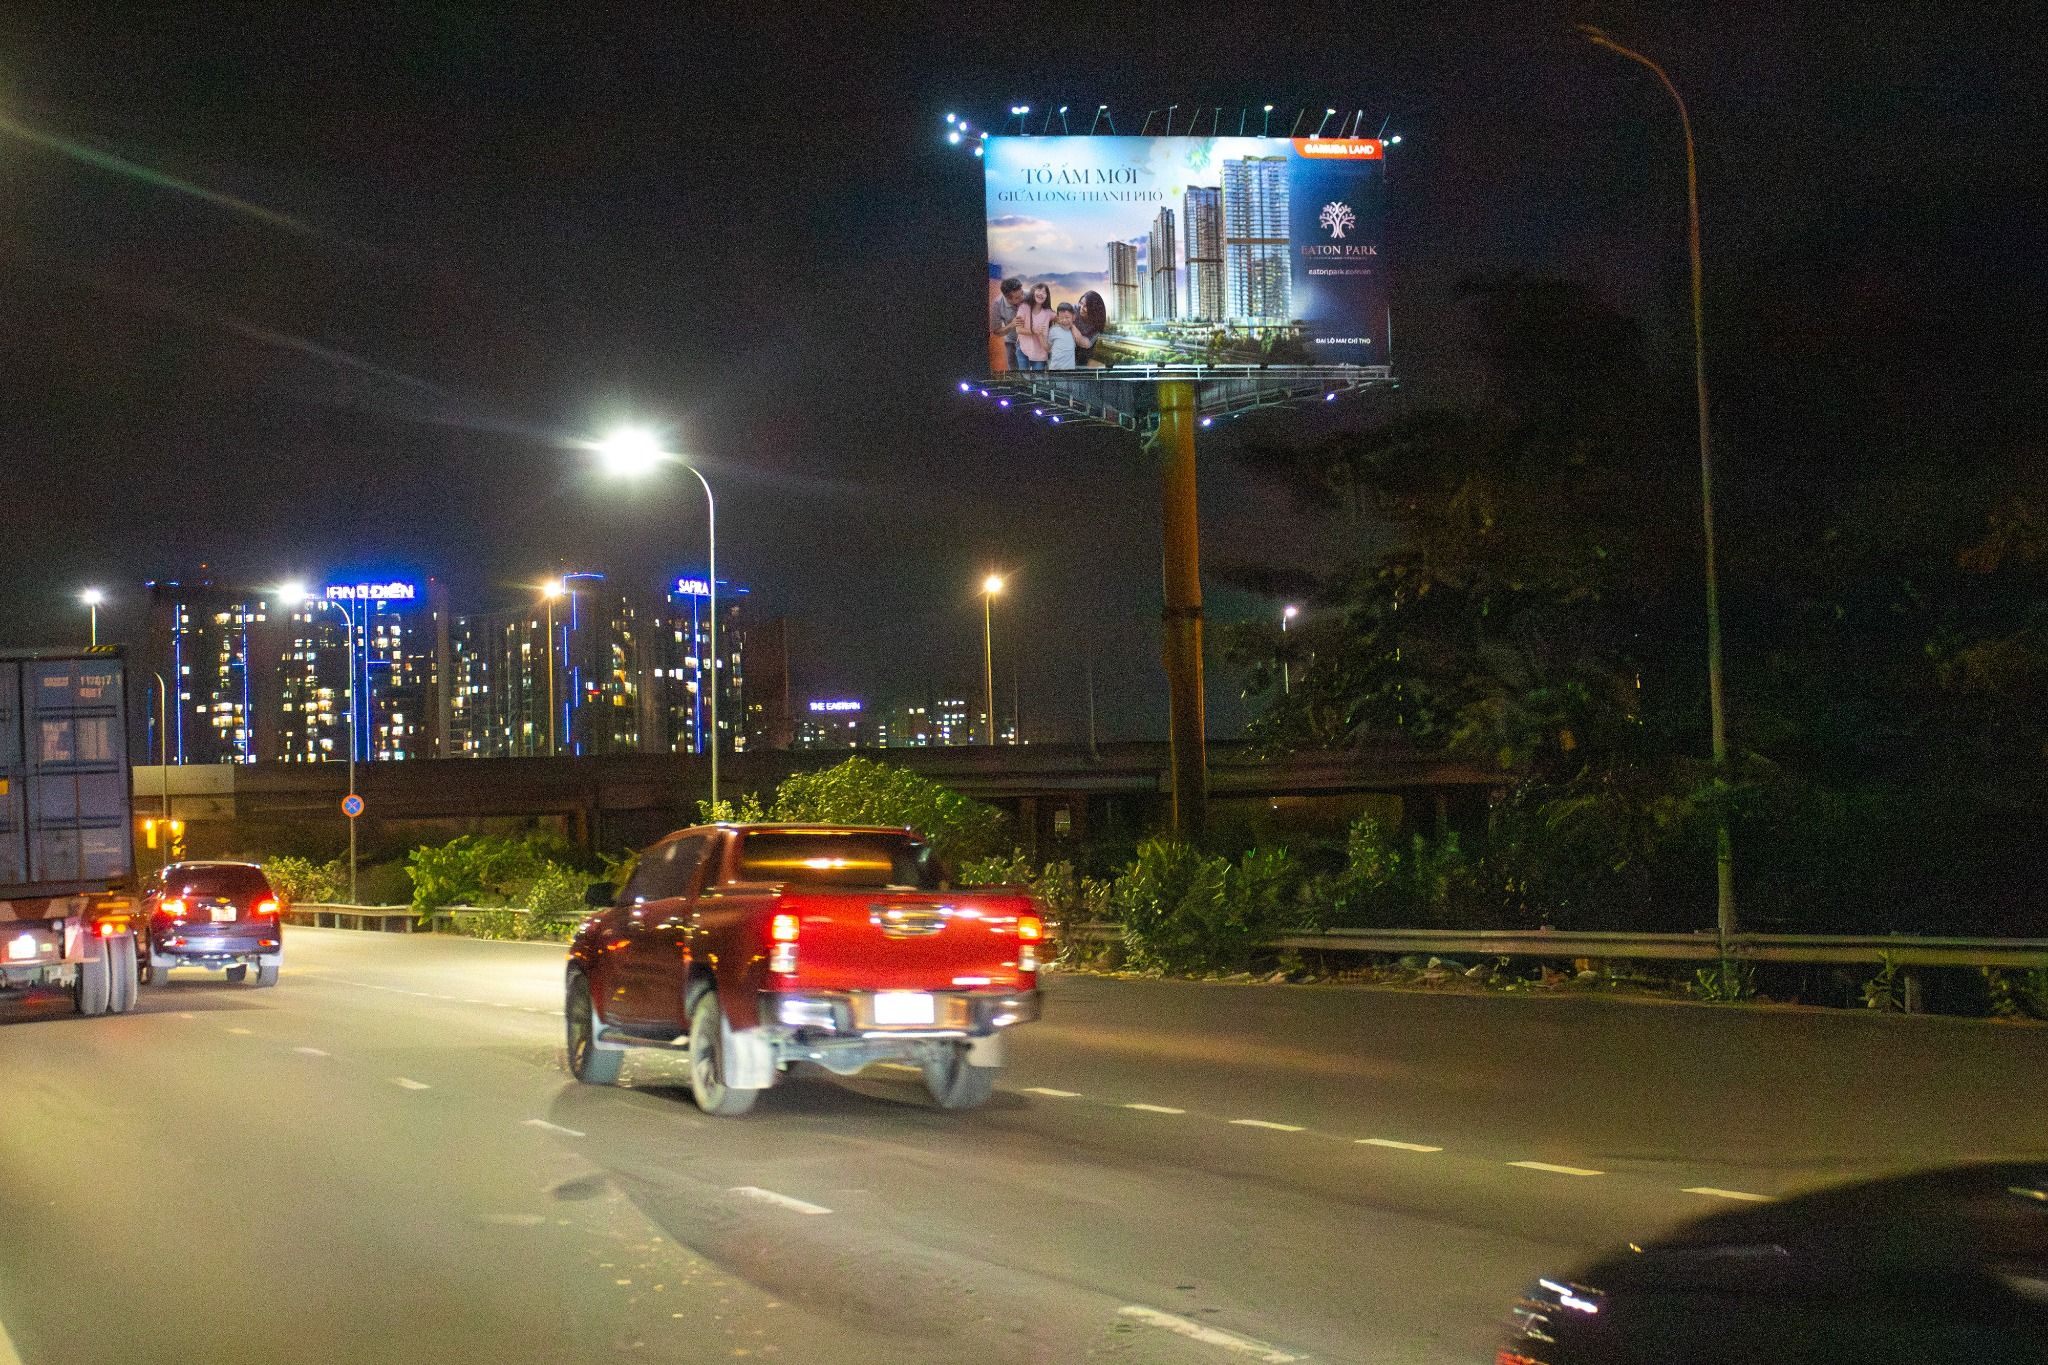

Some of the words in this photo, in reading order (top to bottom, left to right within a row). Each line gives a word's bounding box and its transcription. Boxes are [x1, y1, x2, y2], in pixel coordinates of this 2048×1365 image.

[1348, 144, 1375, 156] LAND
[1301, 245, 1342, 256] EATON
[1345, 245, 1378, 256] PARK
